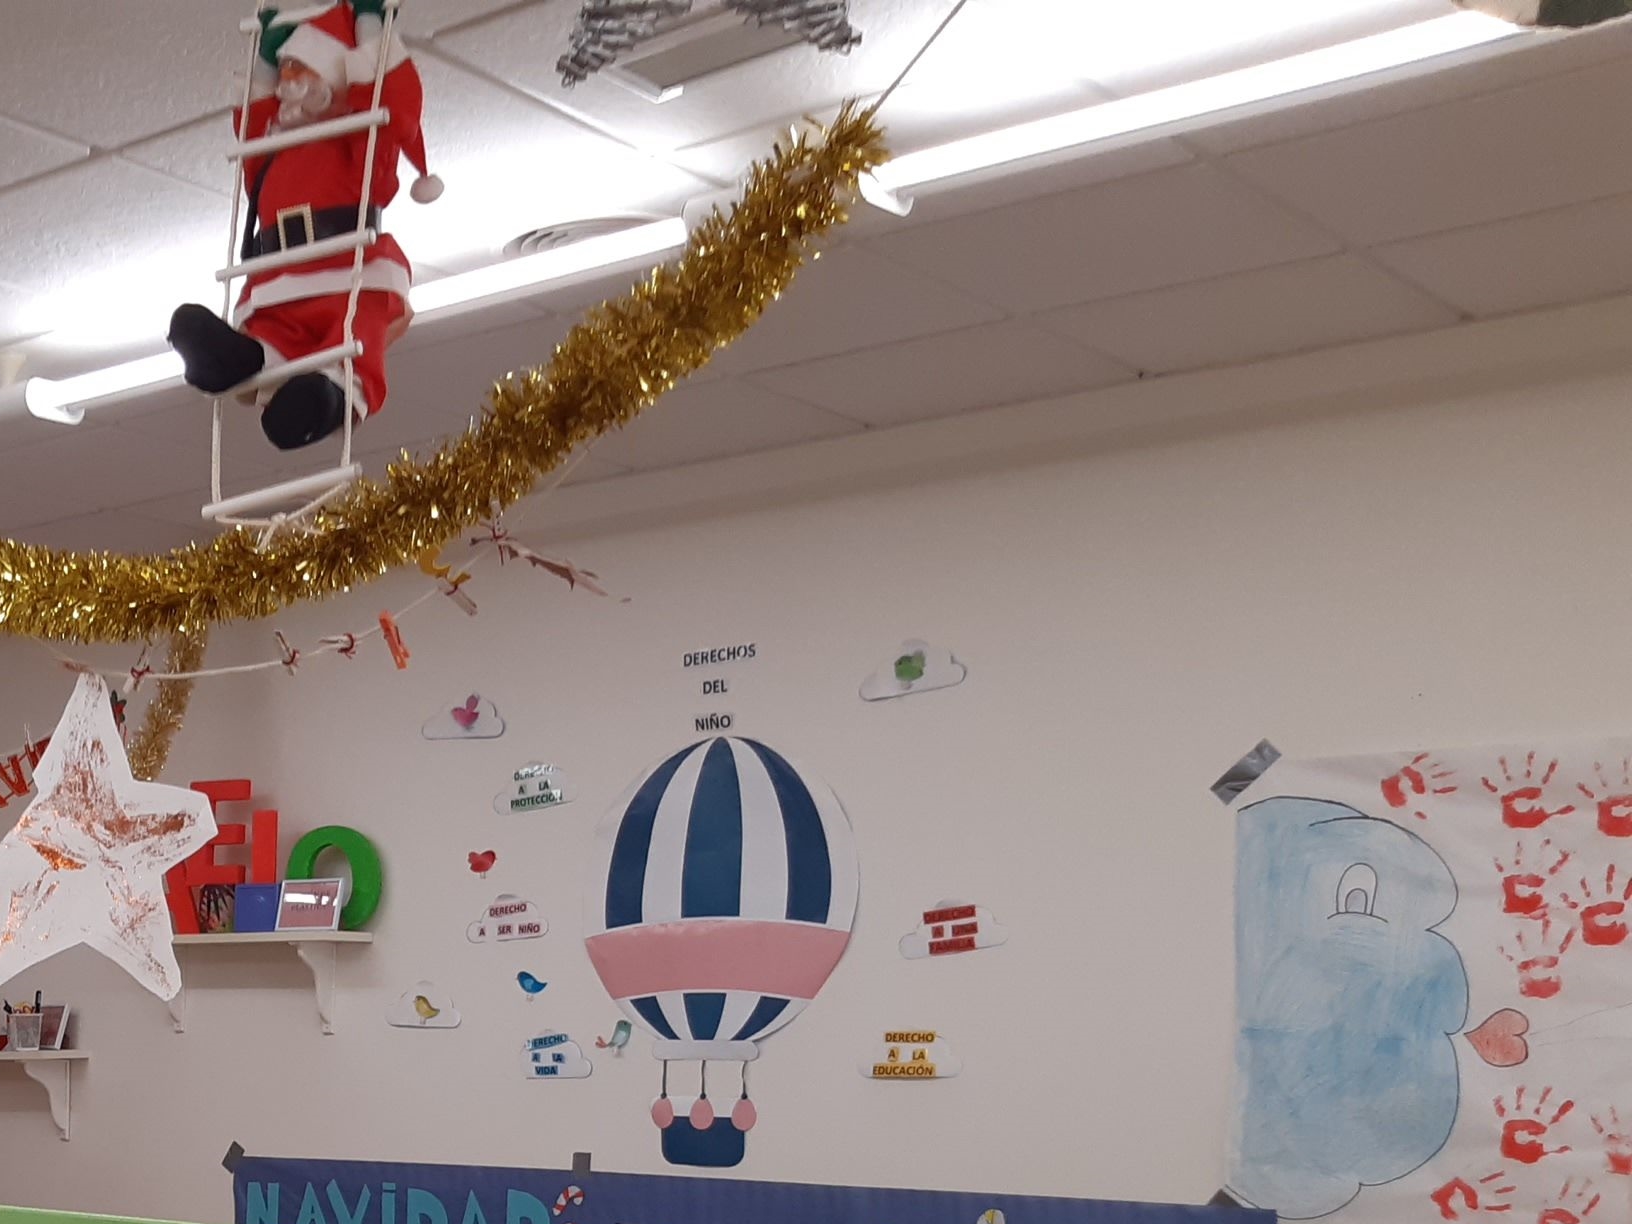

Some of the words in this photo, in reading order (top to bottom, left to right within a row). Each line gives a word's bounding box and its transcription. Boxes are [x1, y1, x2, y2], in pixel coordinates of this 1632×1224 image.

[683, 643, 757, 668] DERECHOS
[702, 679, 728, 695] DEL
[694, 712, 732, 732] NIÑO
[538, 780, 550, 791] LA
[489, 903, 528, 918] DERECHO
[478, 927, 486, 937] A
[497, 925, 512, 936] SER
[518, 922, 541, 935] NIÑO
[885, 1032, 935, 1043] DERECHO
[888, 1048, 896, 1059] A
[912, 1050, 926, 1061] LA
[535, 1066, 558, 1075] VIDA
[872, 1064, 934, 1076] EDUCACIÓN
